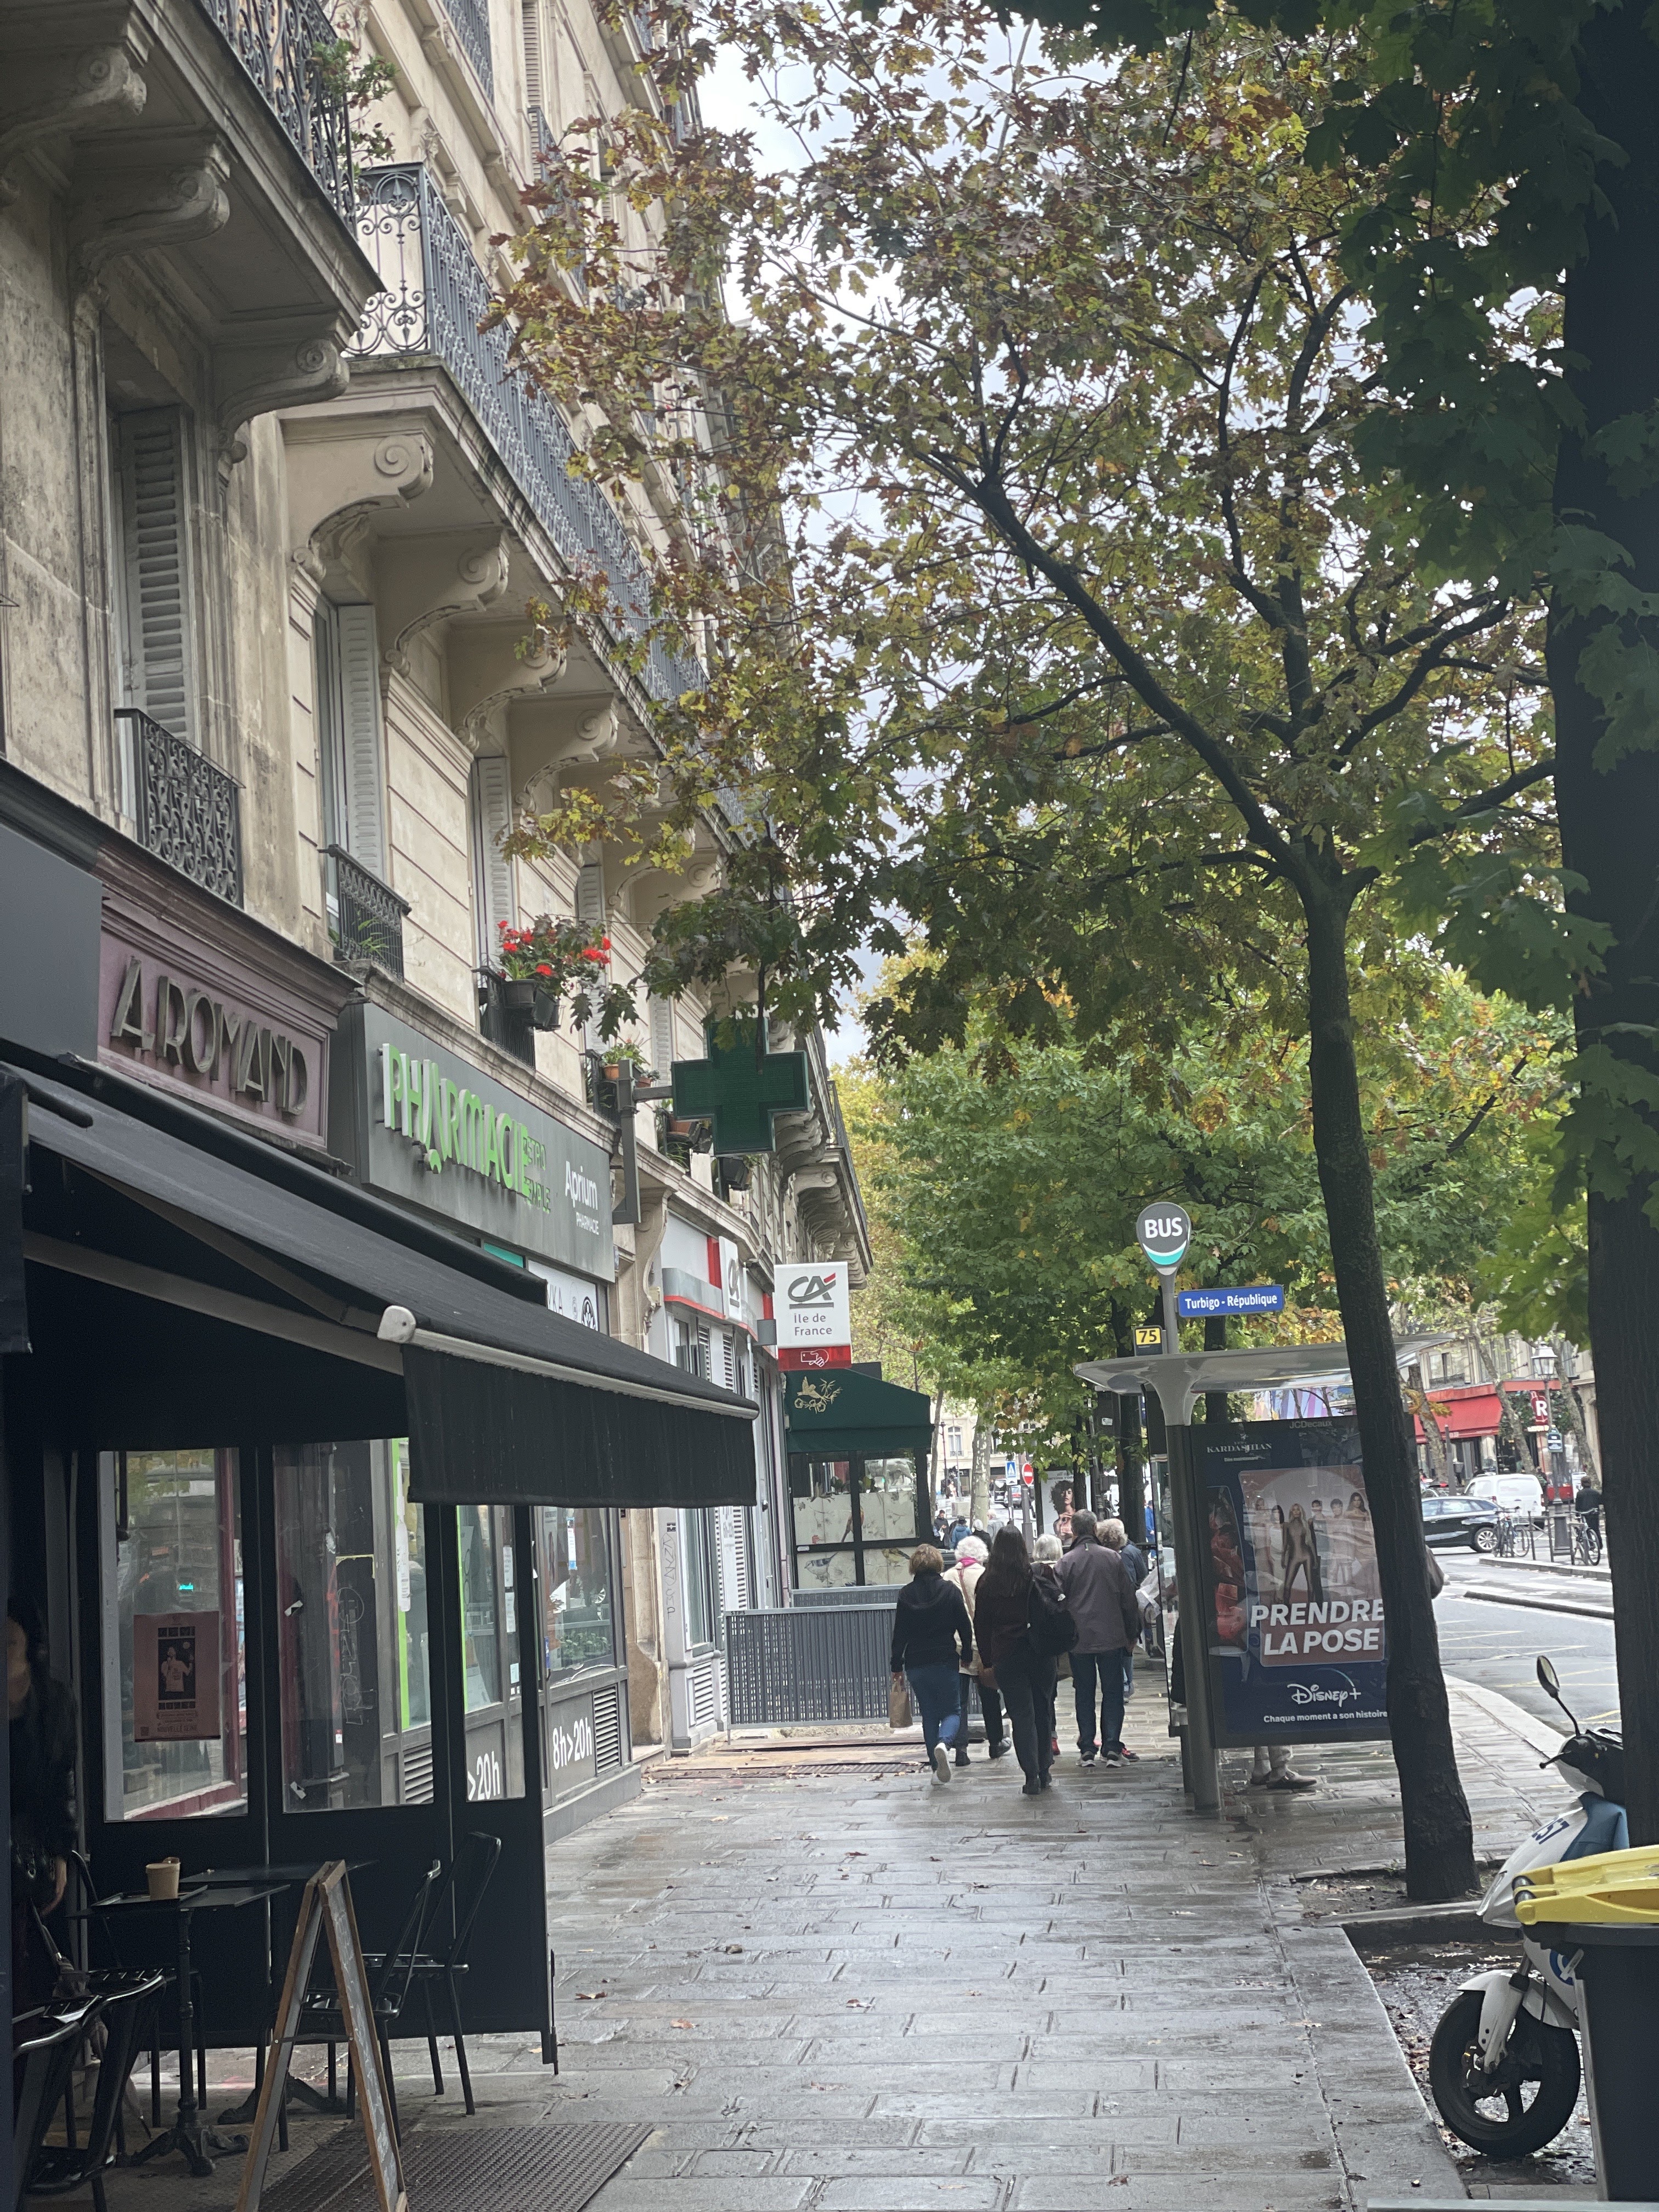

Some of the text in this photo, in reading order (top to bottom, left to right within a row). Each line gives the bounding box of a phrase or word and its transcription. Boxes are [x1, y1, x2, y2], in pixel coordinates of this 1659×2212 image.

[110, 956, 308, 1116] AROMAND
[382, 1043, 531, 1198] PHARMACIE
[565, 1160, 598, 1210] Aprium
[575, 1211, 599, 1235] PHARMACIE
[1144, 1217, 1183, 1238] BUS
[1184, 1297, 1220, 1310] Turbigo
[1227, 1294, 1278, 1308] République
[812, 1313, 826, 1323] de
[795, 1327, 832, 1336] France
[1139, 1330, 1157, 1342] 75
[1536, 1400, 1548, 1417] R
[1289, 1420, 1333, 1429] JCDecaux
[1250, 1599, 1385, 1627] PRENDRE
[1264, 1628, 1380, 1656] LA POSE
[1263, 1715, 1295, 1724] Chaque
[1297, 1713, 1331, 1722] moment
[1356, 1709, 1388, 1718] histoire
